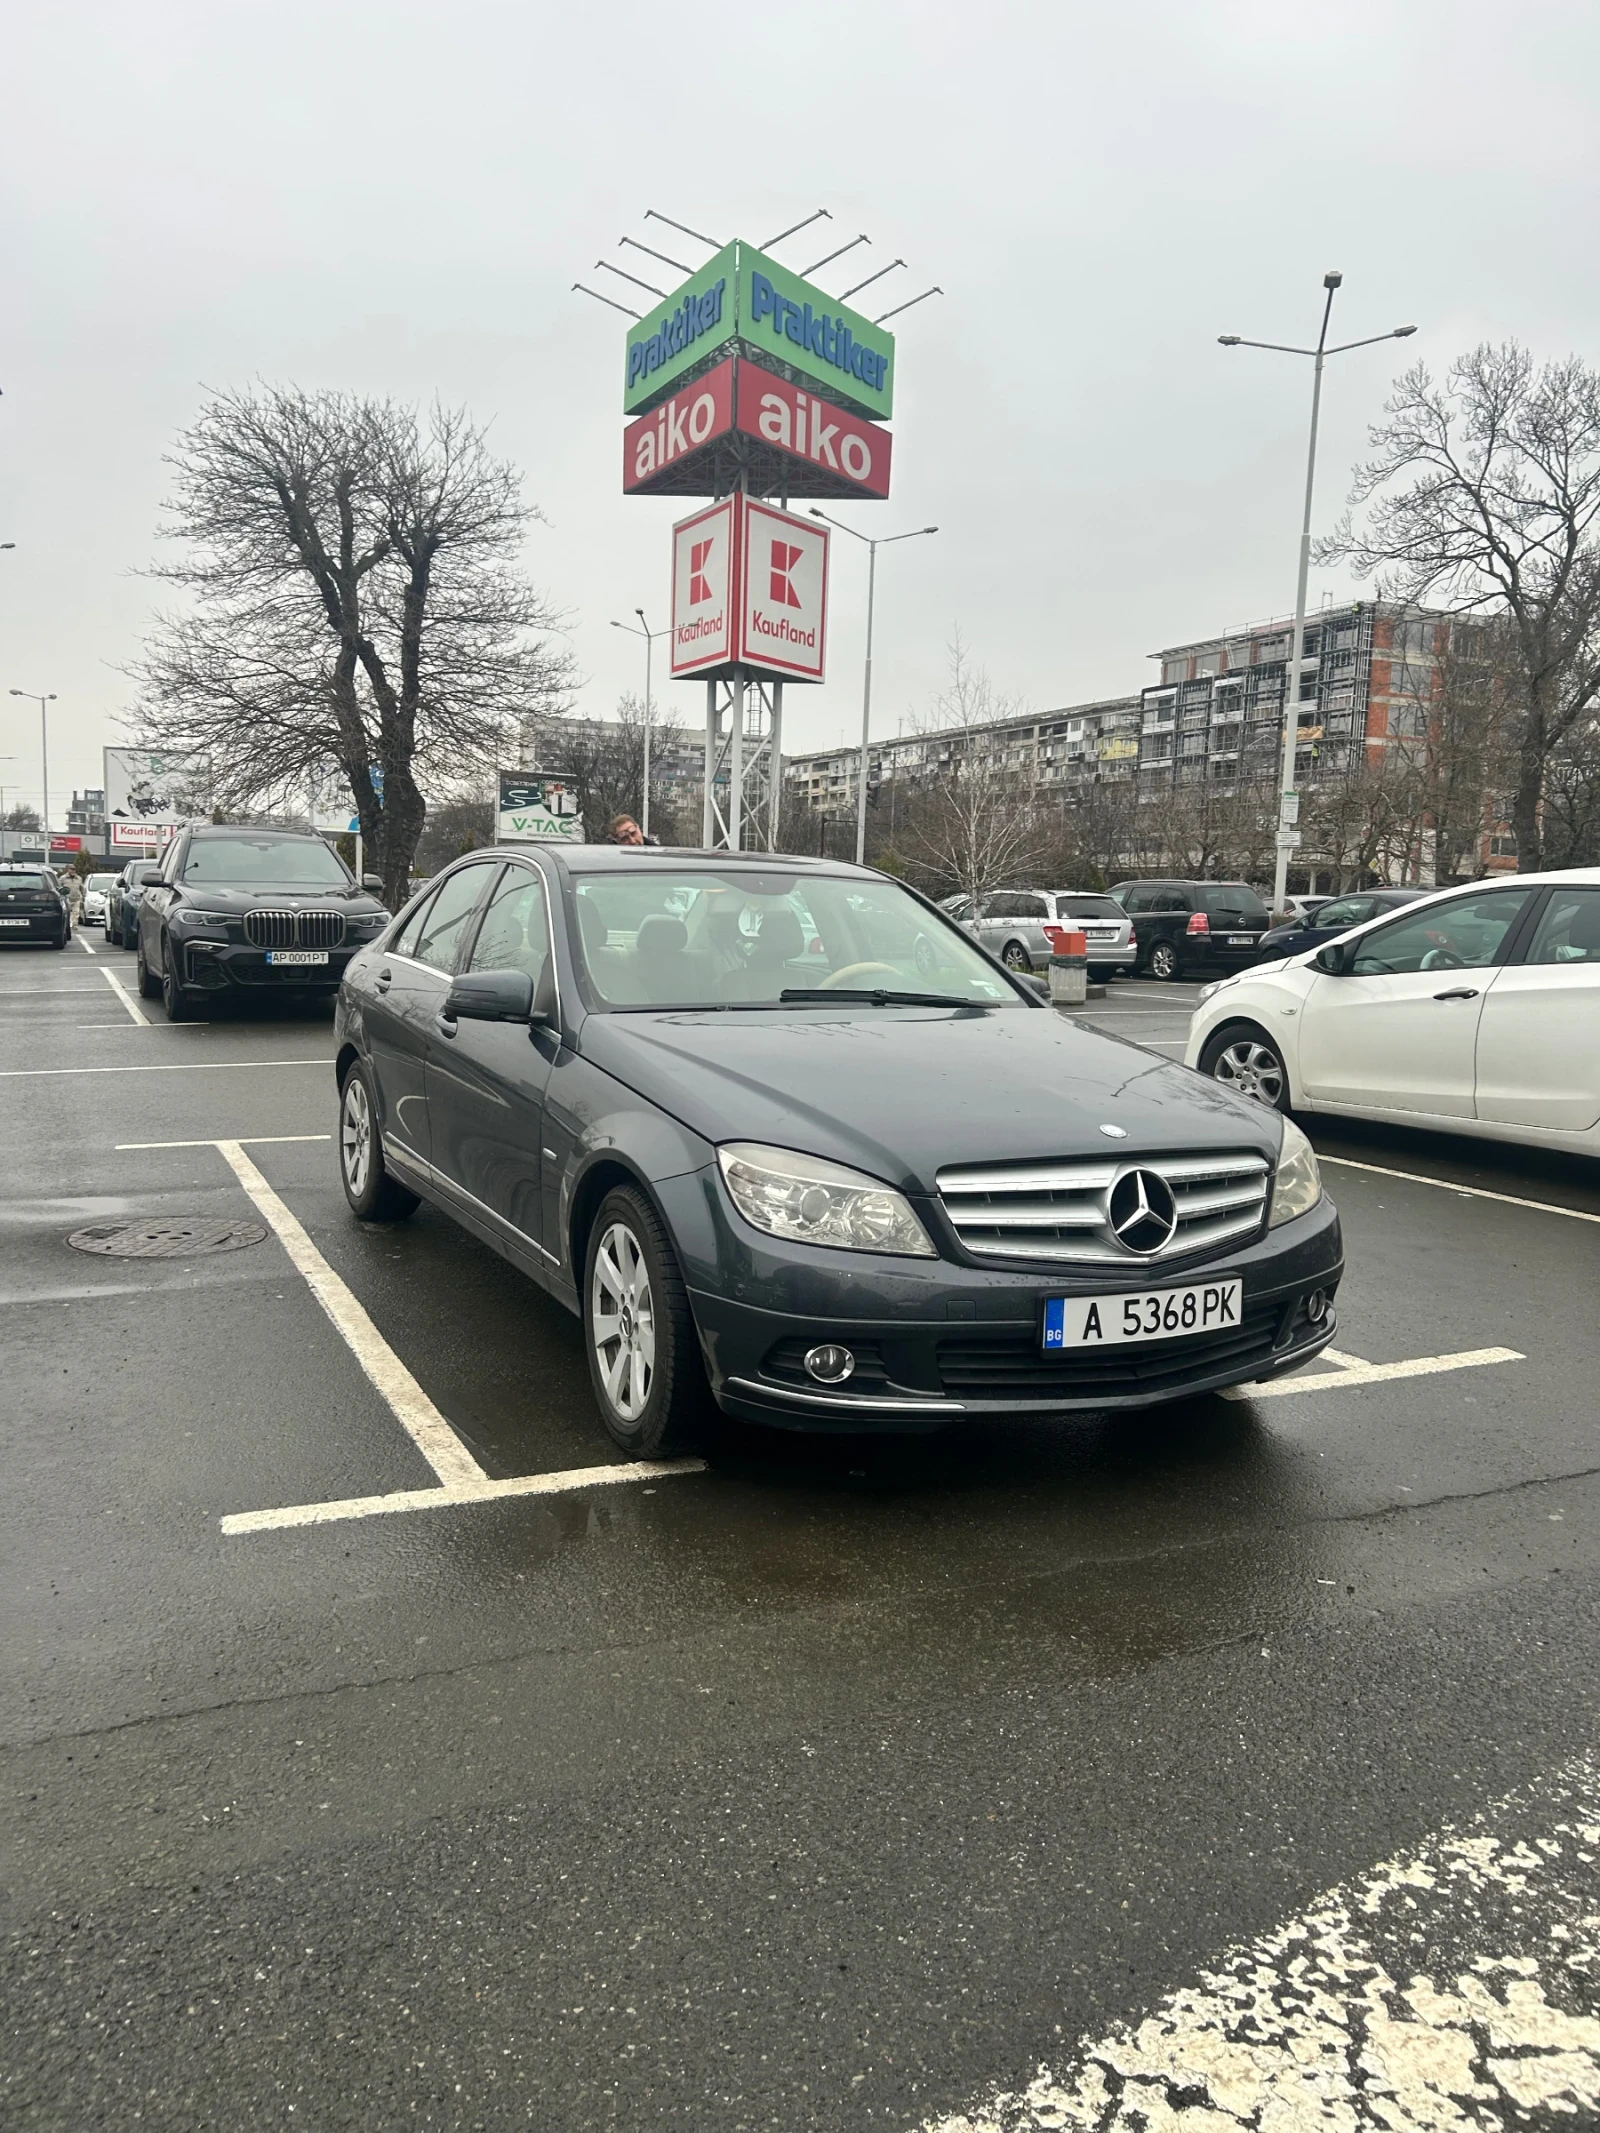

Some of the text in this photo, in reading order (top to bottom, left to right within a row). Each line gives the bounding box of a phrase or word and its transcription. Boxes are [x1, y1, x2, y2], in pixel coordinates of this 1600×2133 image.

[628, 277, 725, 388] Praktiker
[751, 270, 888, 392] Praktiker
[635, 392, 715, 479] aiko
[759, 393, 872, 481] aiko
[678, 610, 723, 645] Kaufland
[752, 610, 815, 648] Kaufland
[511, 817, 572, 834] V-TAC
[273, 953, 286, 962] AP
[1046, 1329, 1062, 1342] BG
[1082, 1301, 1103, 1341] A
